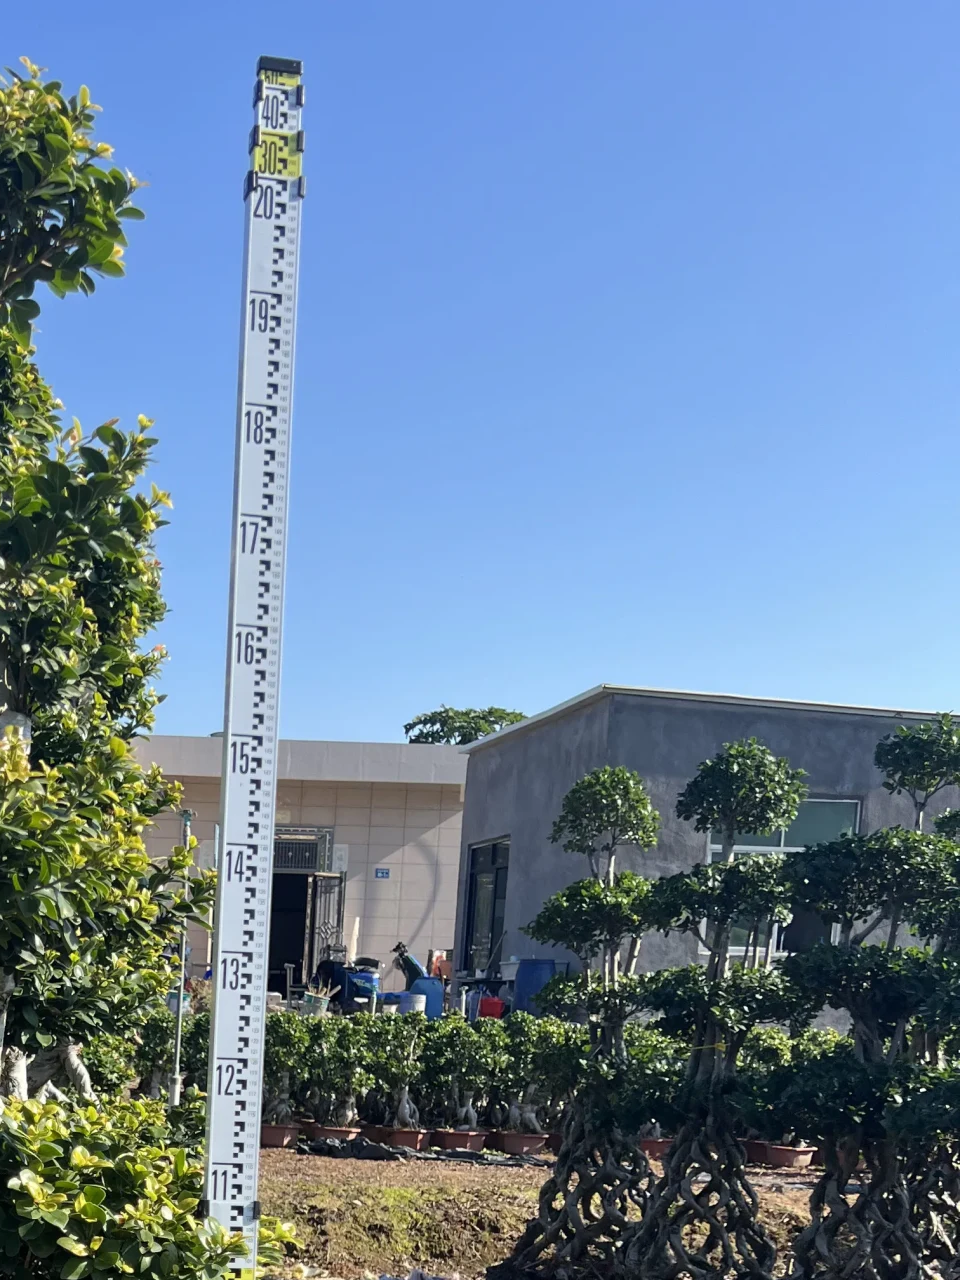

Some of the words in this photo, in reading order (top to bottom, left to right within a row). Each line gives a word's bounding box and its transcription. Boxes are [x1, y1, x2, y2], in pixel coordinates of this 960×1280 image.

[262, 95, 279, 129] 40
[259, 140, 277, 175] 30
[253, 184, 274, 220] 20
[249, 298, 269, 333] 19
[245, 410, 264, 445] 18
[240, 521, 259, 554] 17
[236, 631, 254, 665] 16
[231, 741, 249, 774] 15
[226, 850, 244, 882] 14
[221, 958, 239, 990] 13
[216, 1064, 235, 1096] 12
[212, 1169, 228, 1200] 11
